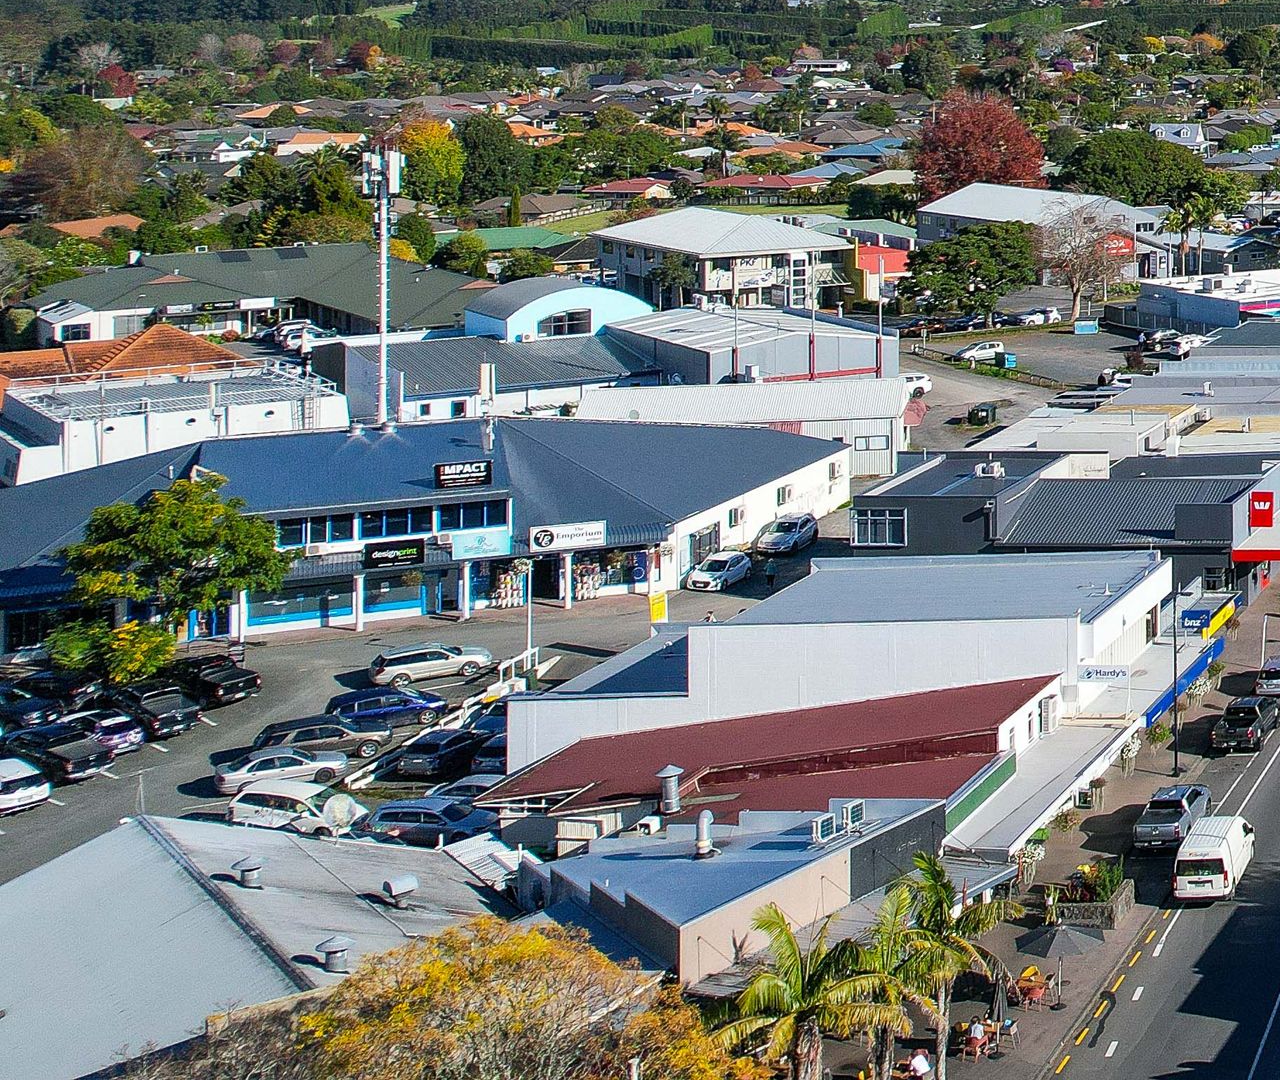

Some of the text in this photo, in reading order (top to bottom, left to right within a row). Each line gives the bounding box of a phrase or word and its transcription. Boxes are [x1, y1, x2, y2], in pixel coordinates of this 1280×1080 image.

[556, 530, 602, 540] Emporium
[1184, 617, 1201, 626] bnz
[1095, 669, 1127, 677] Hardy's
